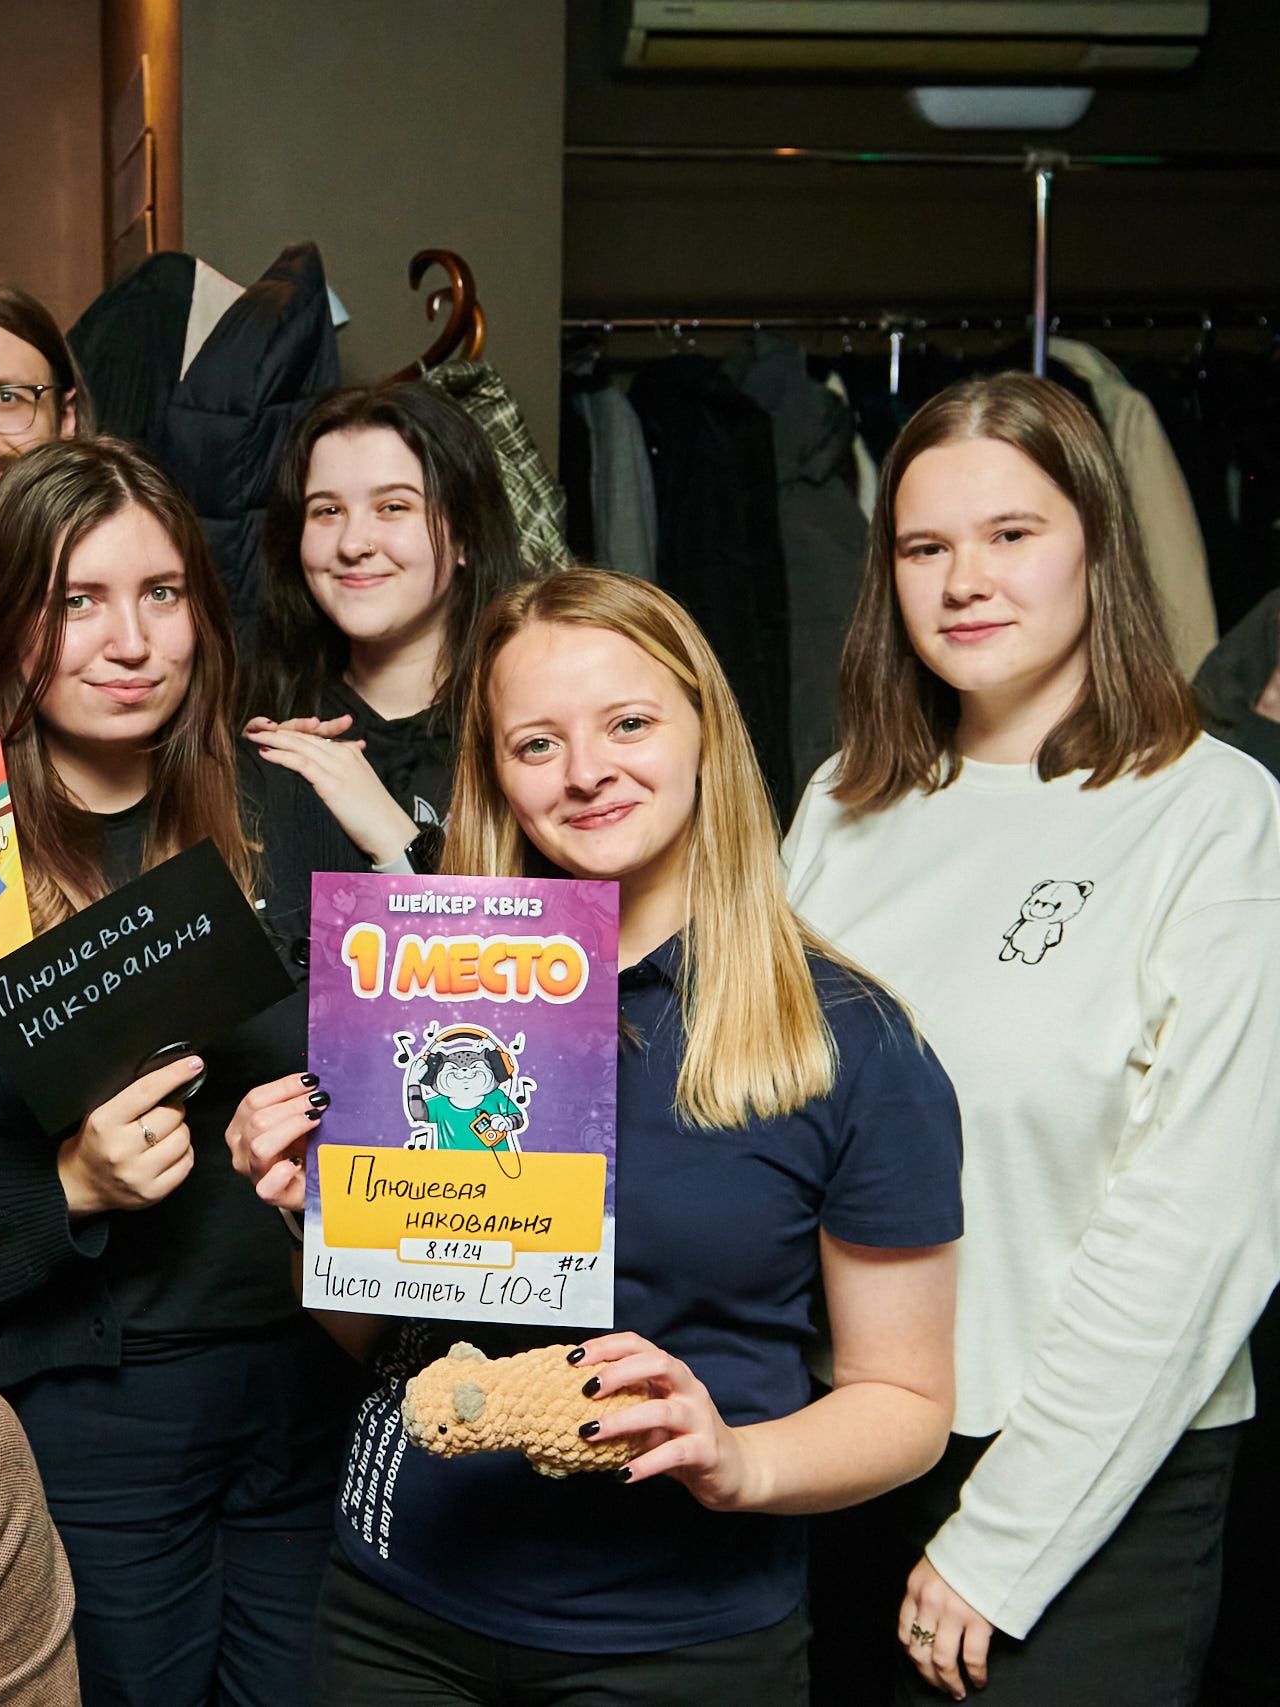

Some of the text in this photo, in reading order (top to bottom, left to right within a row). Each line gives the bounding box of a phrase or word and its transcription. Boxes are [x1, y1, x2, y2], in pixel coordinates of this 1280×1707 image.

[388, 890, 544, 917] ШЕЙКЕР КВИЗ
[18, 913, 213, 1048] наковальня
[346, 926, 586, 1000] 1 МЕСТО
[347, 1154, 487, 1202] Плюшевая
[425, 1240, 482, 1261] 8.11.24
[557, 1256, 598, 1272] #2.1
[314, 1254, 382, 1299] Чисто
[393, 1279, 467, 1304] попеть
[374, 1407, 400, 1471] produ
[350, 1476, 364, 1510] The
[357, 1439, 373, 1477] line
[365, 1467, 380, 1507] line
[363, 1504, 375, 1544] that
[378, 1499, 394, 1539] any
[378, 1536, 390, 1560] at
